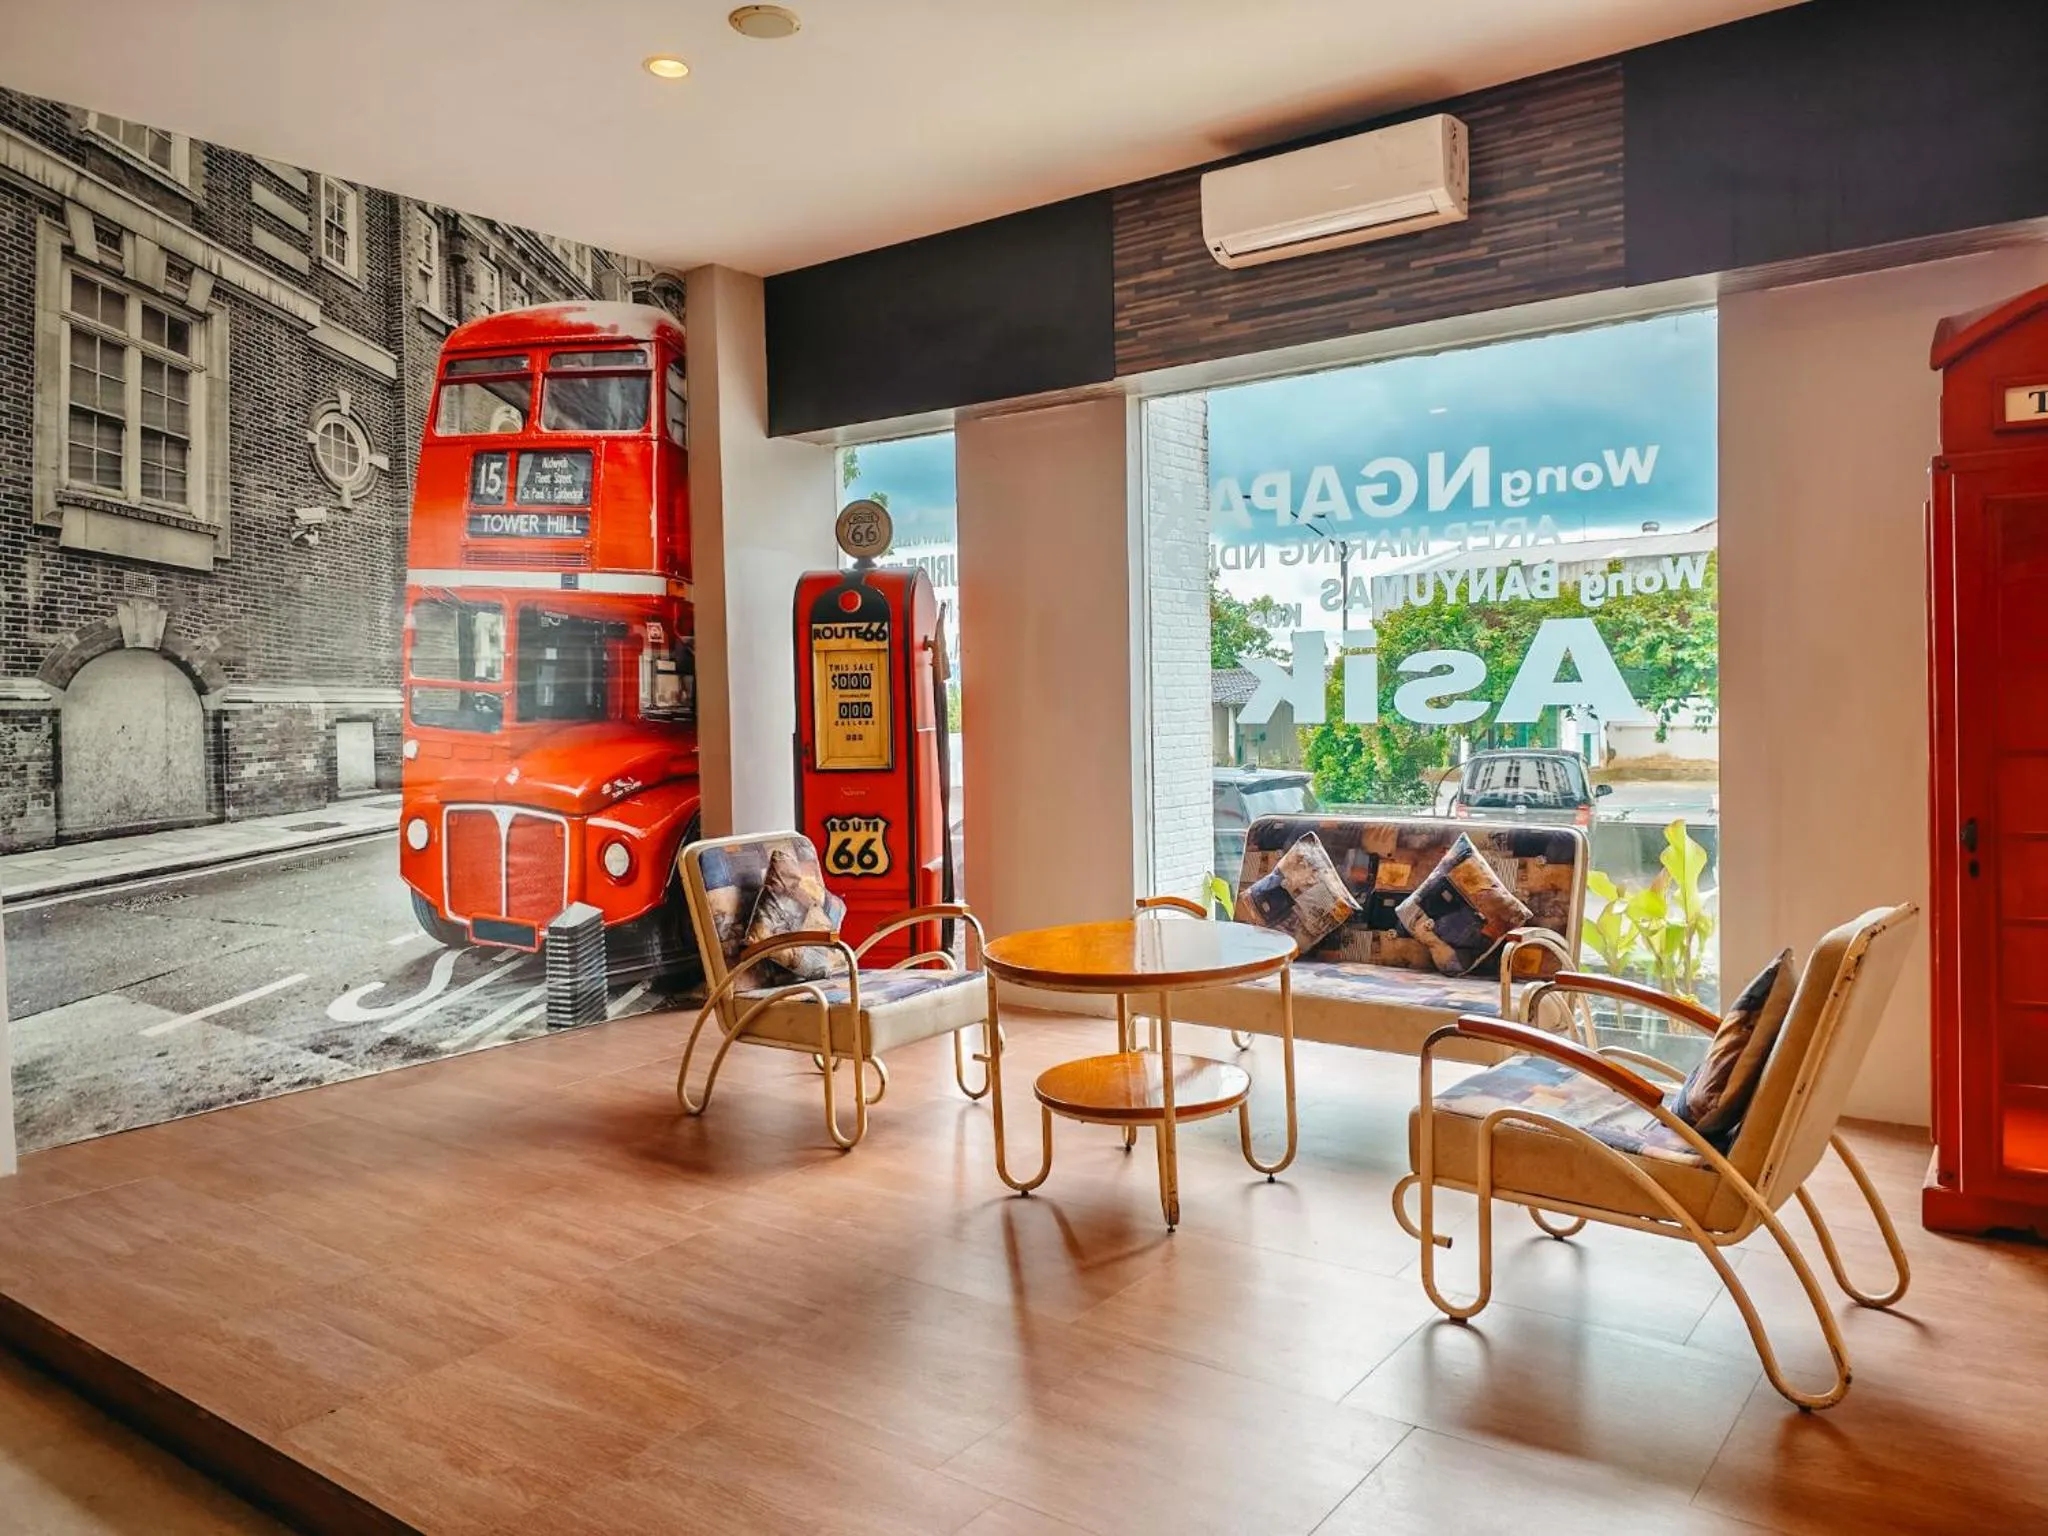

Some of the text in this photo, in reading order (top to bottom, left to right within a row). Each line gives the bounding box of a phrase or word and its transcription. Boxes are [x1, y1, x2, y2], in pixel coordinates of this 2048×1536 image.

[479, 461, 503, 496] 15
[535, 472, 573, 485] Fleet Street
[481, 514, 582, 534] TOWER HILL
[852, 524, 877, 544] 66
[829, 663, 874, 672] THIS SALE
[829, 820, 879, 833] ROUTE
[833, 838, 879, 870] 66
